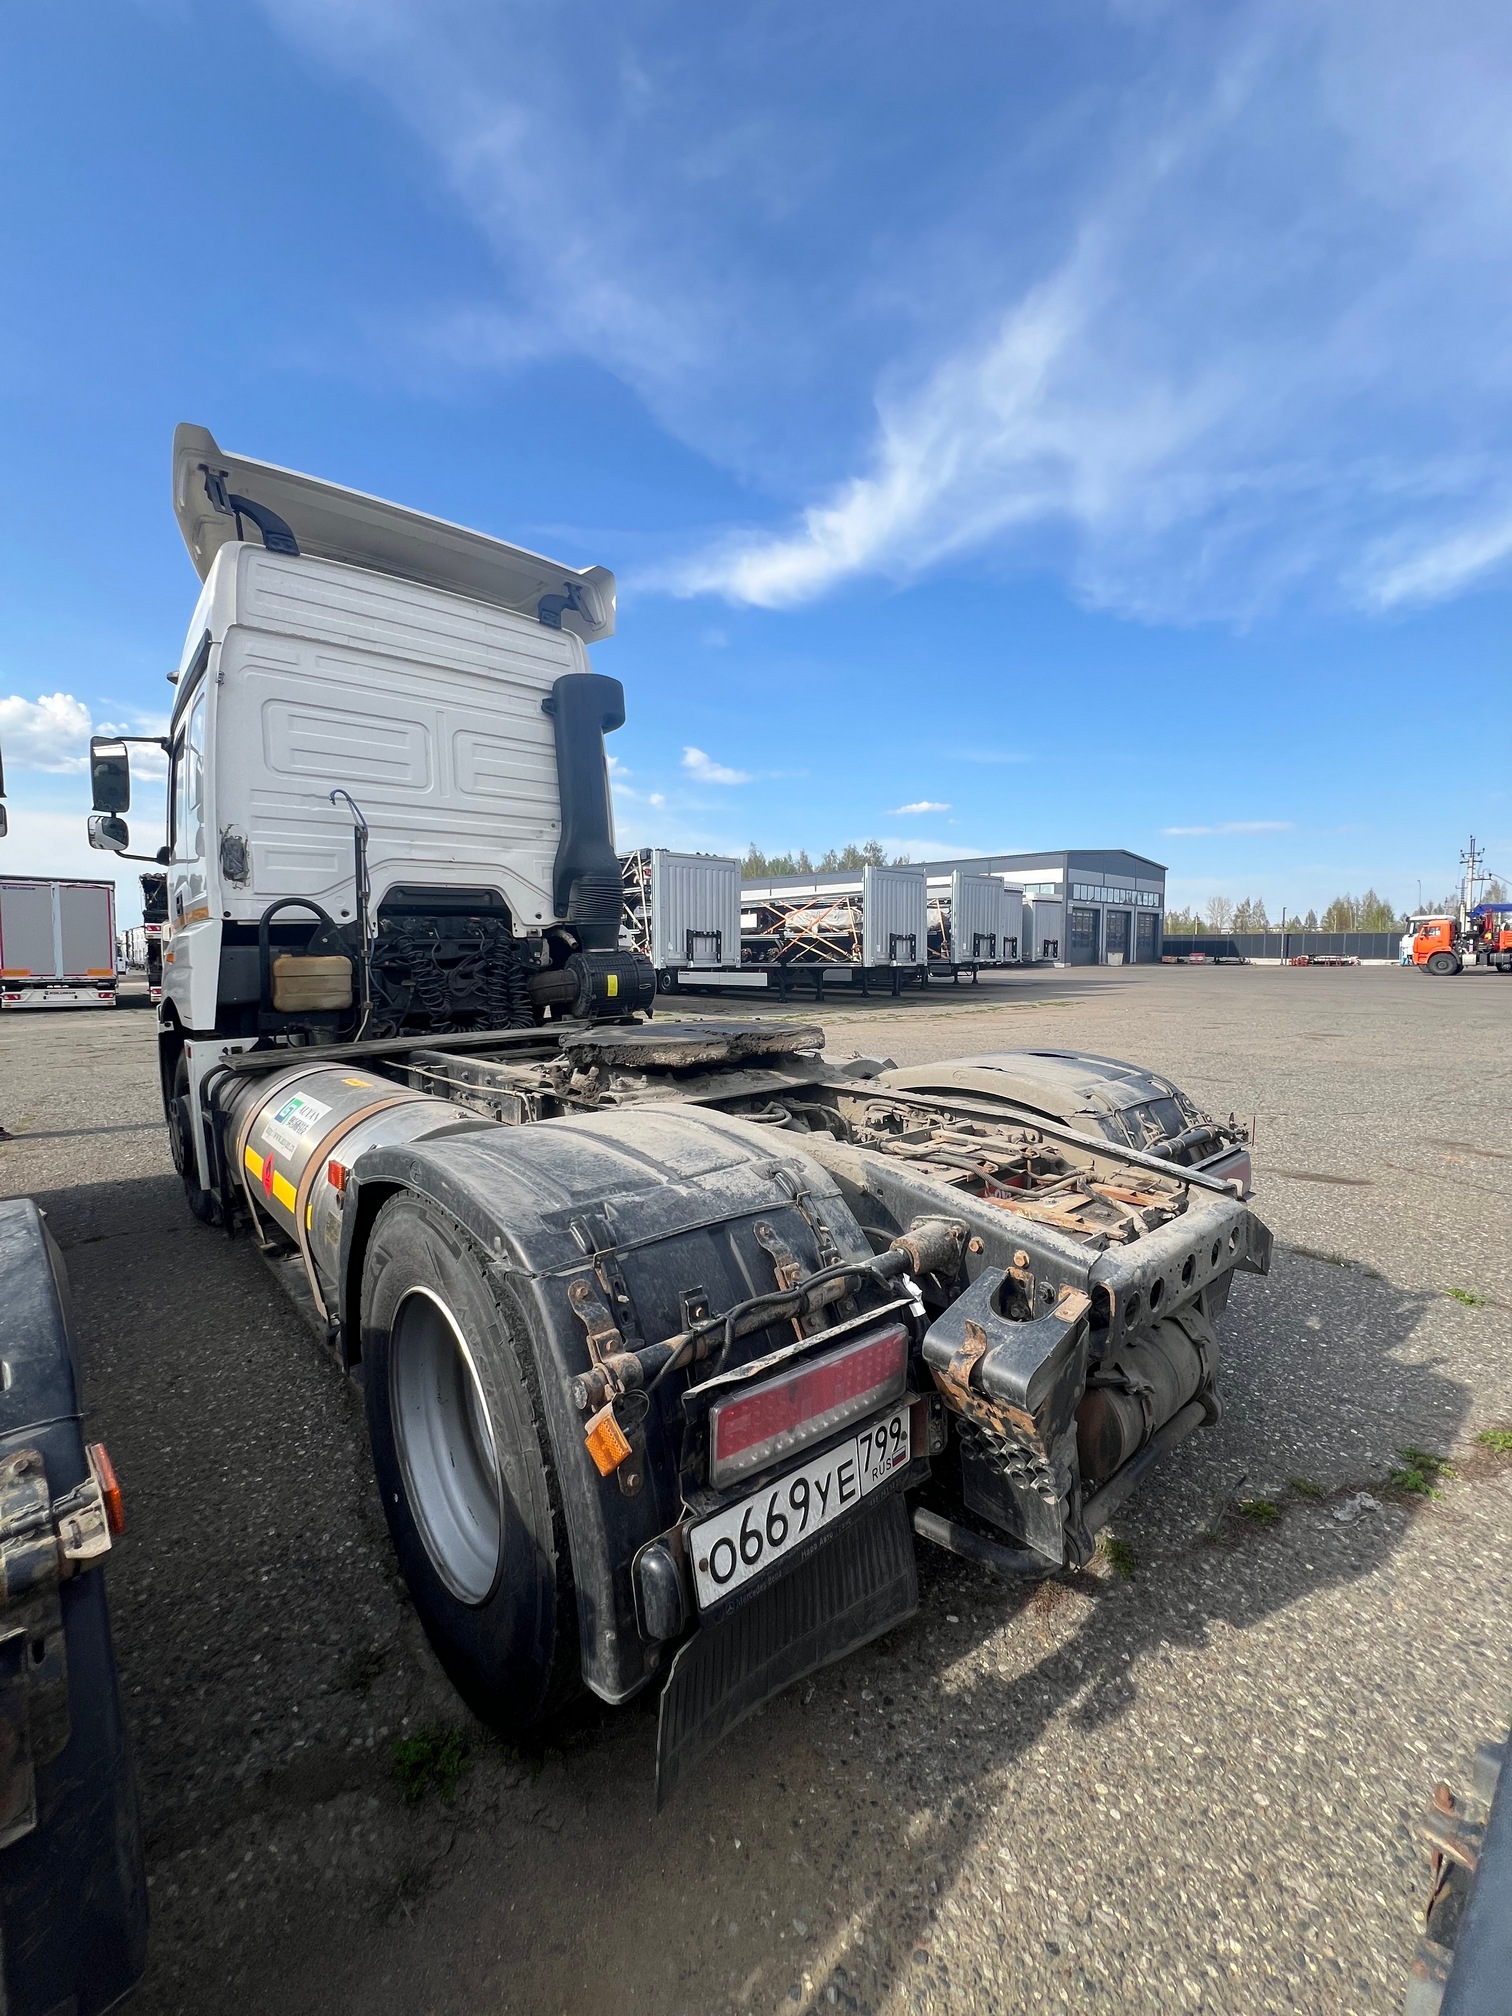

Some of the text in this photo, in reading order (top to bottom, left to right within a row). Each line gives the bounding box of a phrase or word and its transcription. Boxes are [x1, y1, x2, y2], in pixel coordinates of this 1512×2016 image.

[709, 1416, 902, 1585] О669УЕ 799
[871, 1458, 892, 1482] RUS
